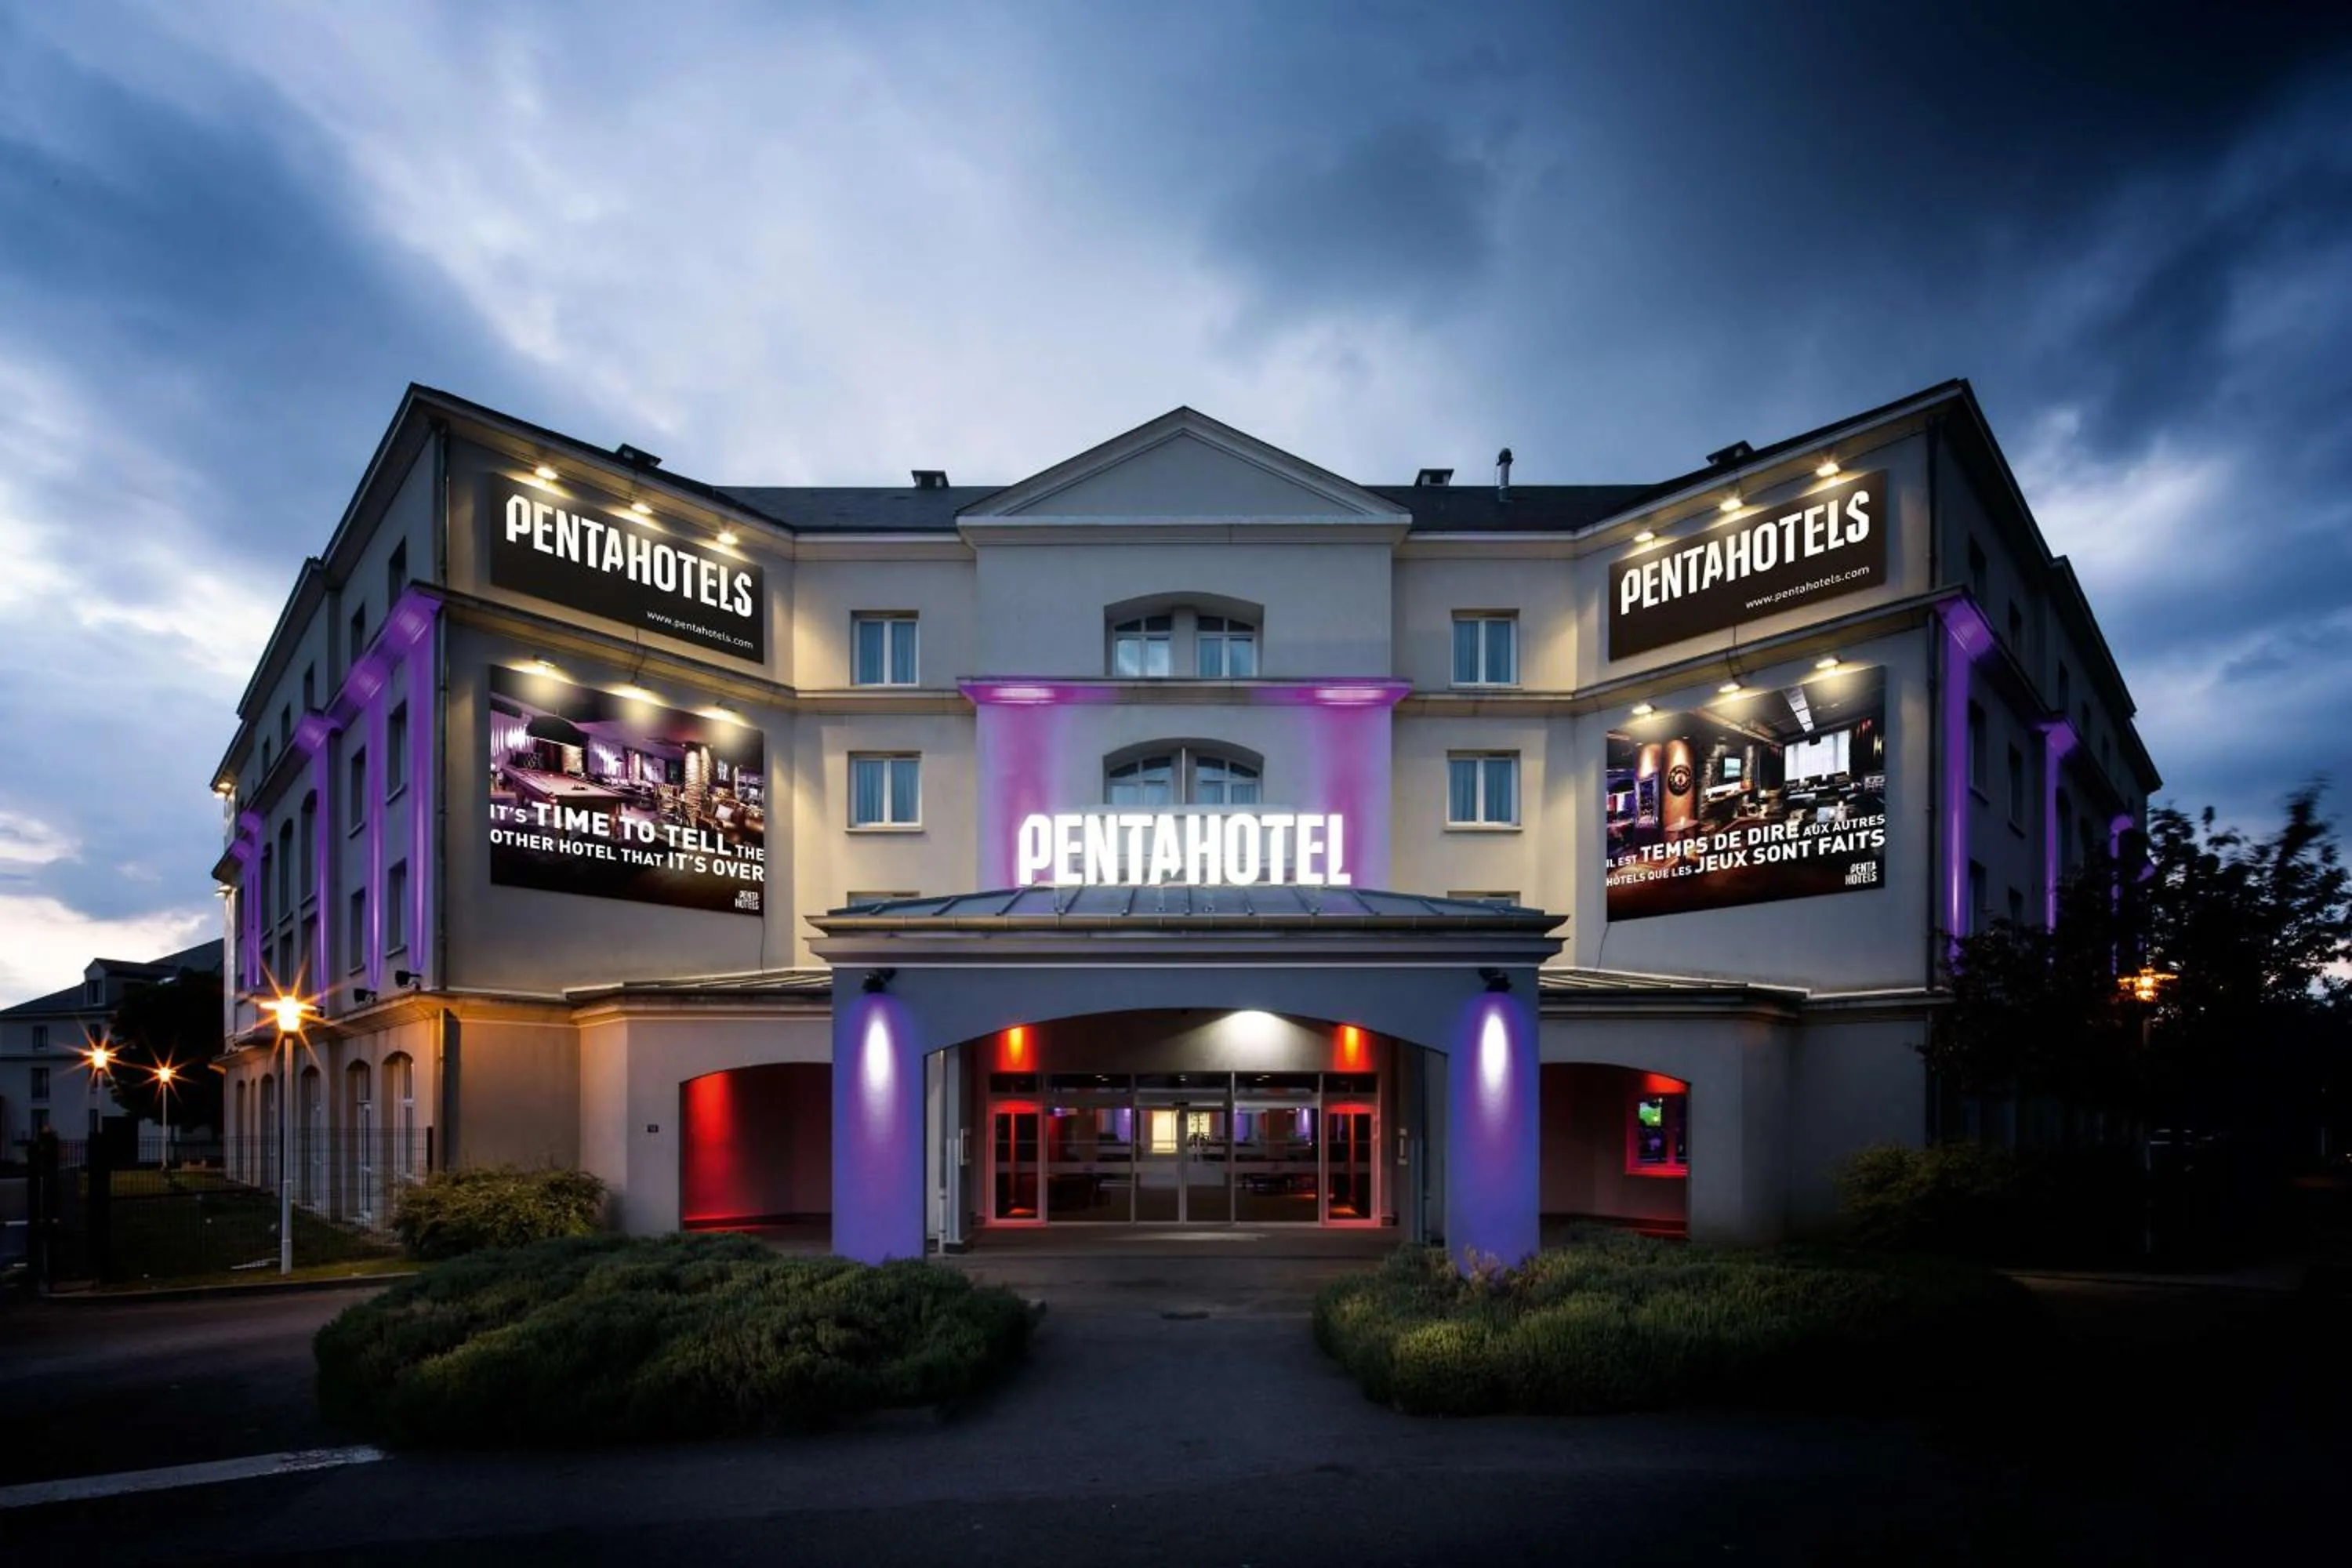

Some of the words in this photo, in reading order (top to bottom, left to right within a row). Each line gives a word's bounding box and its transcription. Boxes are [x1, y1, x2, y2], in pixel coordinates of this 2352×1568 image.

[506, 493, 753, 617] PENTAHOTELS
[1621, 489, 1870, 615] PENTAHOTELS
[1744, 564, 1870, 609] www.pentahotels.com
[646, 610, 753, 649] www.pentahotels.com
[490, 804, 527, 822] IT'S
[532, 800, 610, 837] TIME
[619, 816, 655, 843] TO
[665, 825, 731, 855] TELL
[735, 844, 764, 861] THE
[490, 829, 554, 851] OTHER
[559, 839, 616, 861] HOTEL
[621, 849, 663, 866] THAT
[668, 851, 706, 873] IT'S
[713, 859, 764, 881] OVER
[1018, 813, 1351, 885] PENTAHOTEL
[1606, 859, 1616, 868] IL
[1618, 855, 1637, 866] EST
[1640, 837, 1708, 862] TEMPS
[1715, 830, 1741, 851] DE
[1748, 820, 1798, 845] DIRE
[1803, 823, 1829, 837] AUX
[1833, 814, 1886, 832] AUTRES
[1648, 869, 1668, 880] QUE
[1671, 866, 1692, 877] LES
[1695, 849, 1748, 873] JEUX
[1753, 840, 1811, 864] SONT
[1819, 829, 1886, 855] FAITS
[1846, 871, 1877, 885] HOTELS
[1850, 861, 1876, 874] PENTA
